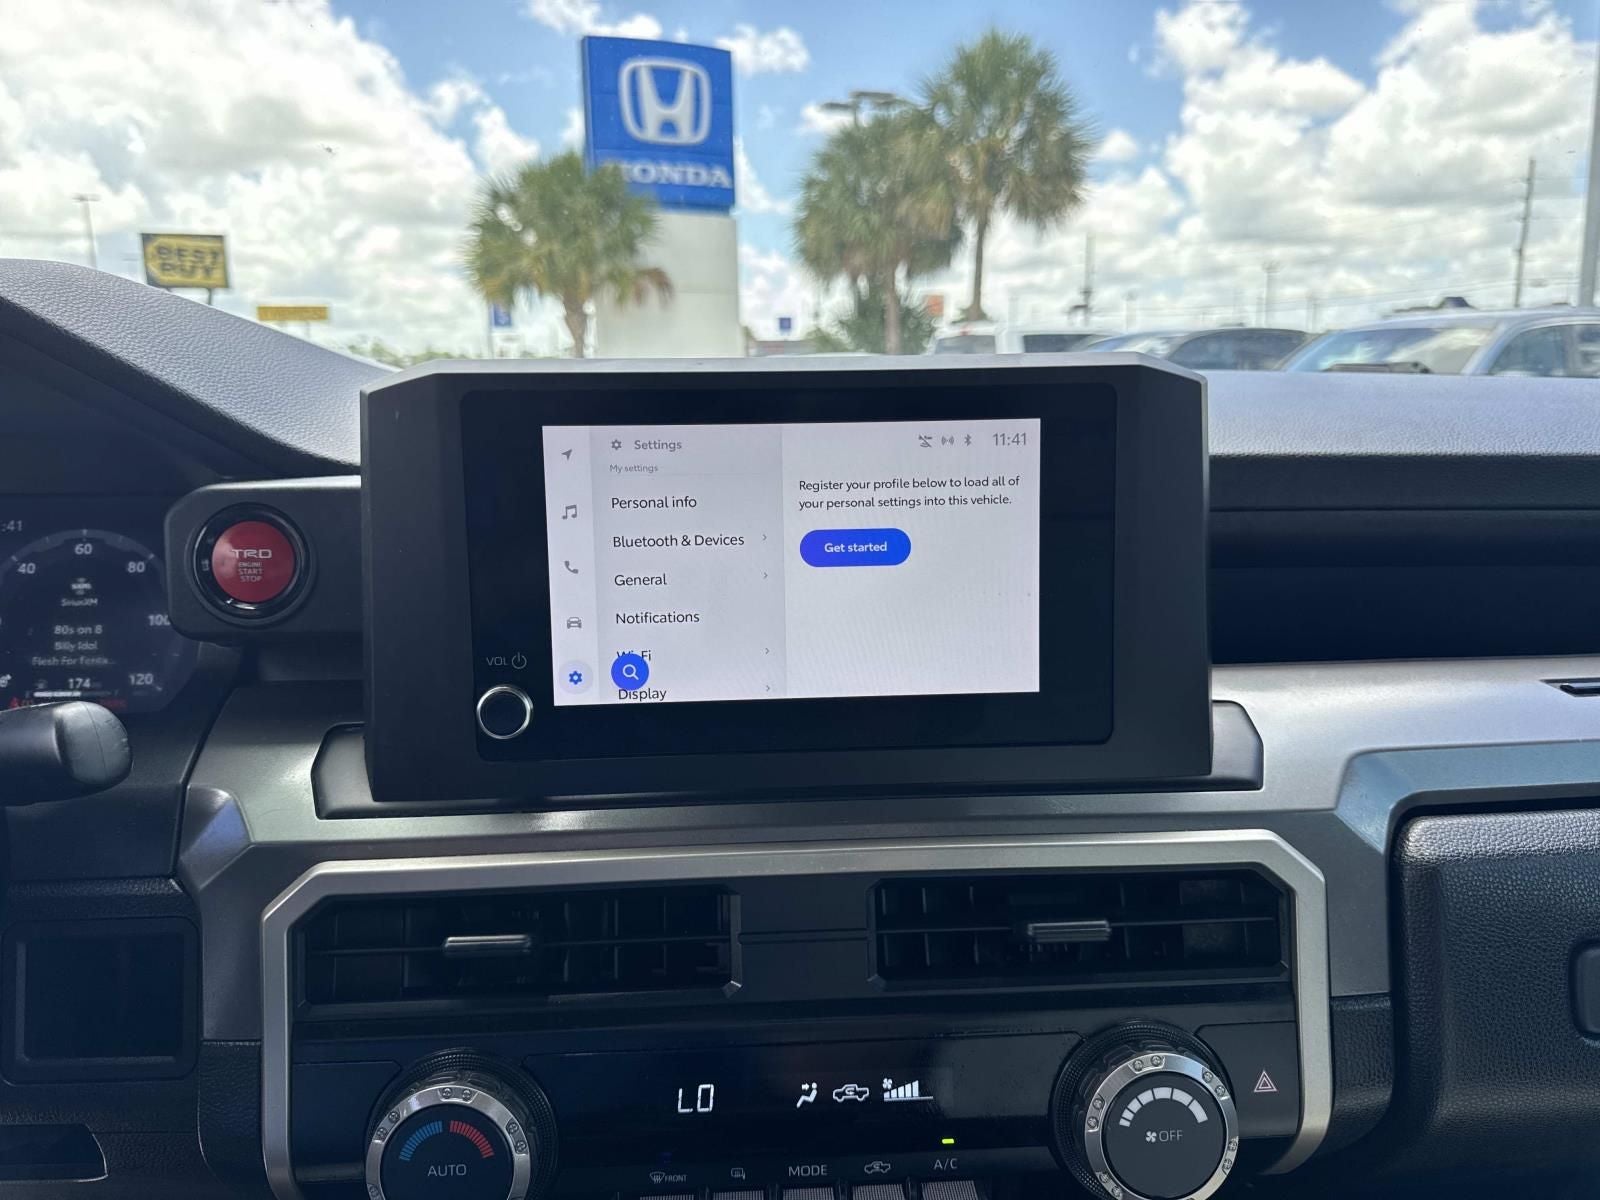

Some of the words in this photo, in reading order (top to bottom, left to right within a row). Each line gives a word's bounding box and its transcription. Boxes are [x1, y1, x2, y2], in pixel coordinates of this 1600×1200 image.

[992, 432, 1027, 446] 11:41
[634, 439, 682, 452] Settings
[609, 463, 622, 474] My
[624, 463, 659, 473] settings
[799, 480, 843, 492] Register
[846, 481, 870, 491] your
[873, 479, 910, 491] profile
[912, 478, 947, 488] below
[949, 478, 962, 488] to
[964, 476, 989, 487] load
[992, 476, 1005, 486] all
[1008, 475, 1020, 486] of
[611, 496, 669, 509] Personal
[672, 496, 697, 508] info
[799, 500, 824, 511] your
[826, 497, 875, 510] personal
[878, 496, 921, 509] settings
[924, 495, 946, 506] into
[948, 495, 968, 505] this
[971, 494, 1012, 505] vehicle.
[613, 534, 678, 548] Bluetooth
[681, 535, 691, 547] &
[694, 533, 745, 546] Devices
[75, 543, 92, 555] 60
[824, 542, 845, 553] Get
[847, 541, 887, 553] started
[232, 549, 273, 559] TRD
[18, 563, 36, 574] 40
[127, 561, 145, 573] 80
[614, 573, 667, 586] General
[616, 611, 700, 624] Notifications
[77, 626, 92, 635] on
[486, 656, 509, 666] VOL
[68, 678, 91, 689] 174
[129, 673, 154, 685] 120
[618, 687, 667, 702] Display
[1158, 1129, 1184, 1143] OFF
[427, 1163, 468, 1177] AUTO
[933, 1158, 958, 1170] A/C
[788, 1164, 828, 1177] MODE
[664, 1174, 688, 1183] FRONT
